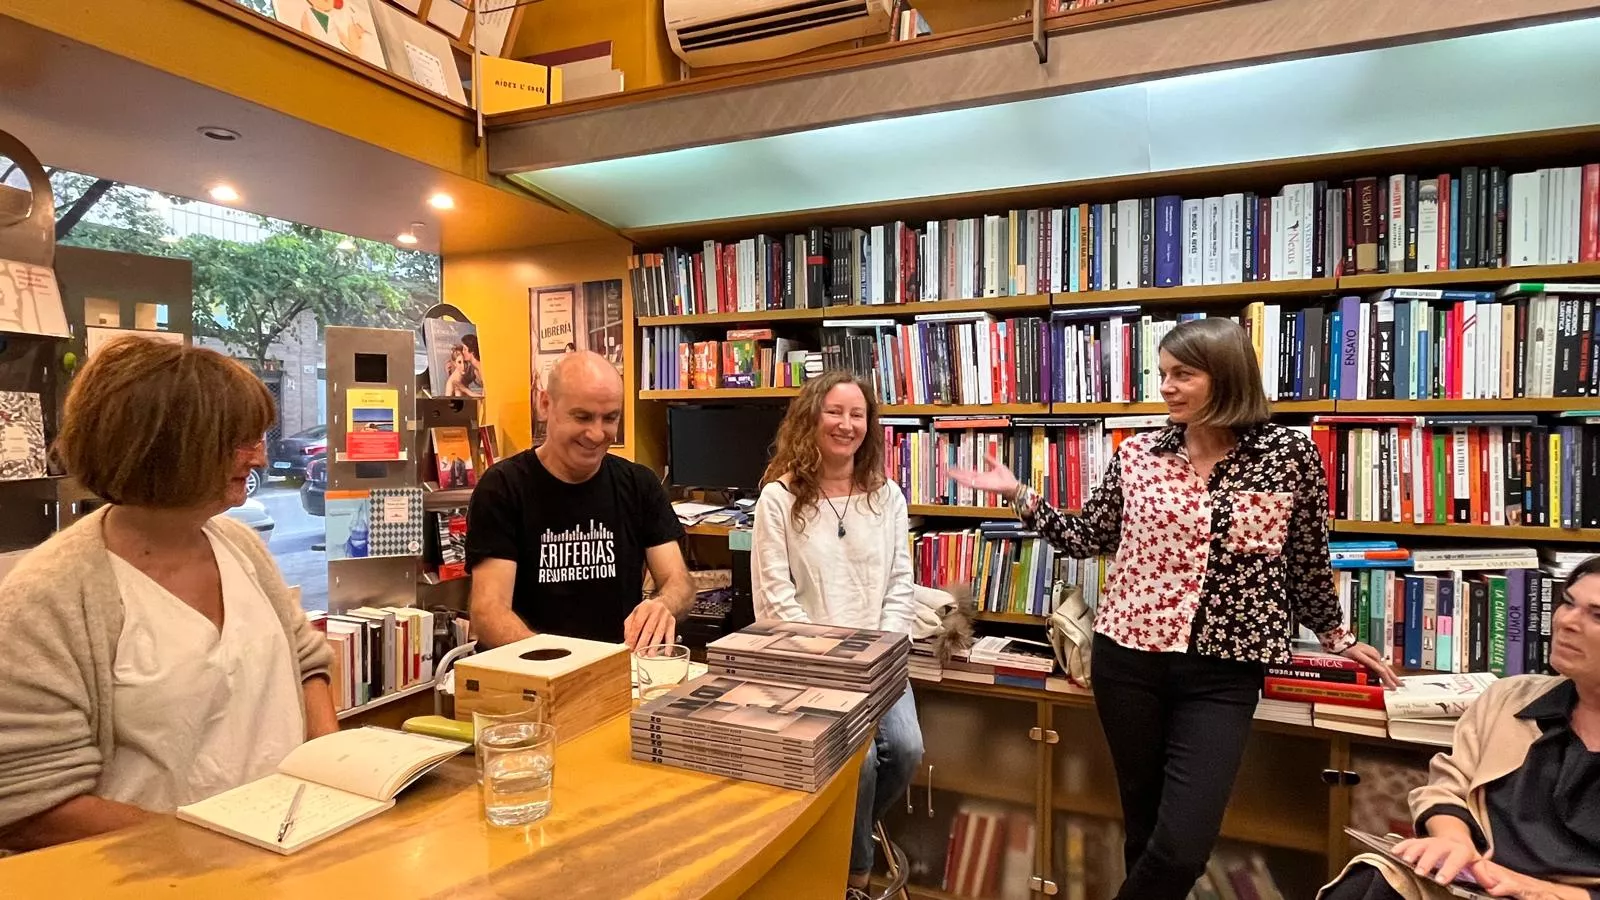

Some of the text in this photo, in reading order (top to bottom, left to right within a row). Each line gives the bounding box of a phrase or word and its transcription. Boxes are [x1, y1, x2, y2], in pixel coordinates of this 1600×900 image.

[1363, 185, 1372, 226] POMPEYA
[1287, 233, 1299, 264] Nexus
[541, 321, 572, 339] LIBRERÍA
[1571, 300, 1579, 336] CONCIENCIA
[1345, 330, 1356, 366] ENSAYO
[1381, 460, 1389, 488] generación
[1495, 590, 1504, 598] LA
[1528, 579, 1539, 632] Bruja moderna
[1510, 605, 1521, 642] HUMOR
[1494, 633, 1504, 665] REBELDE
